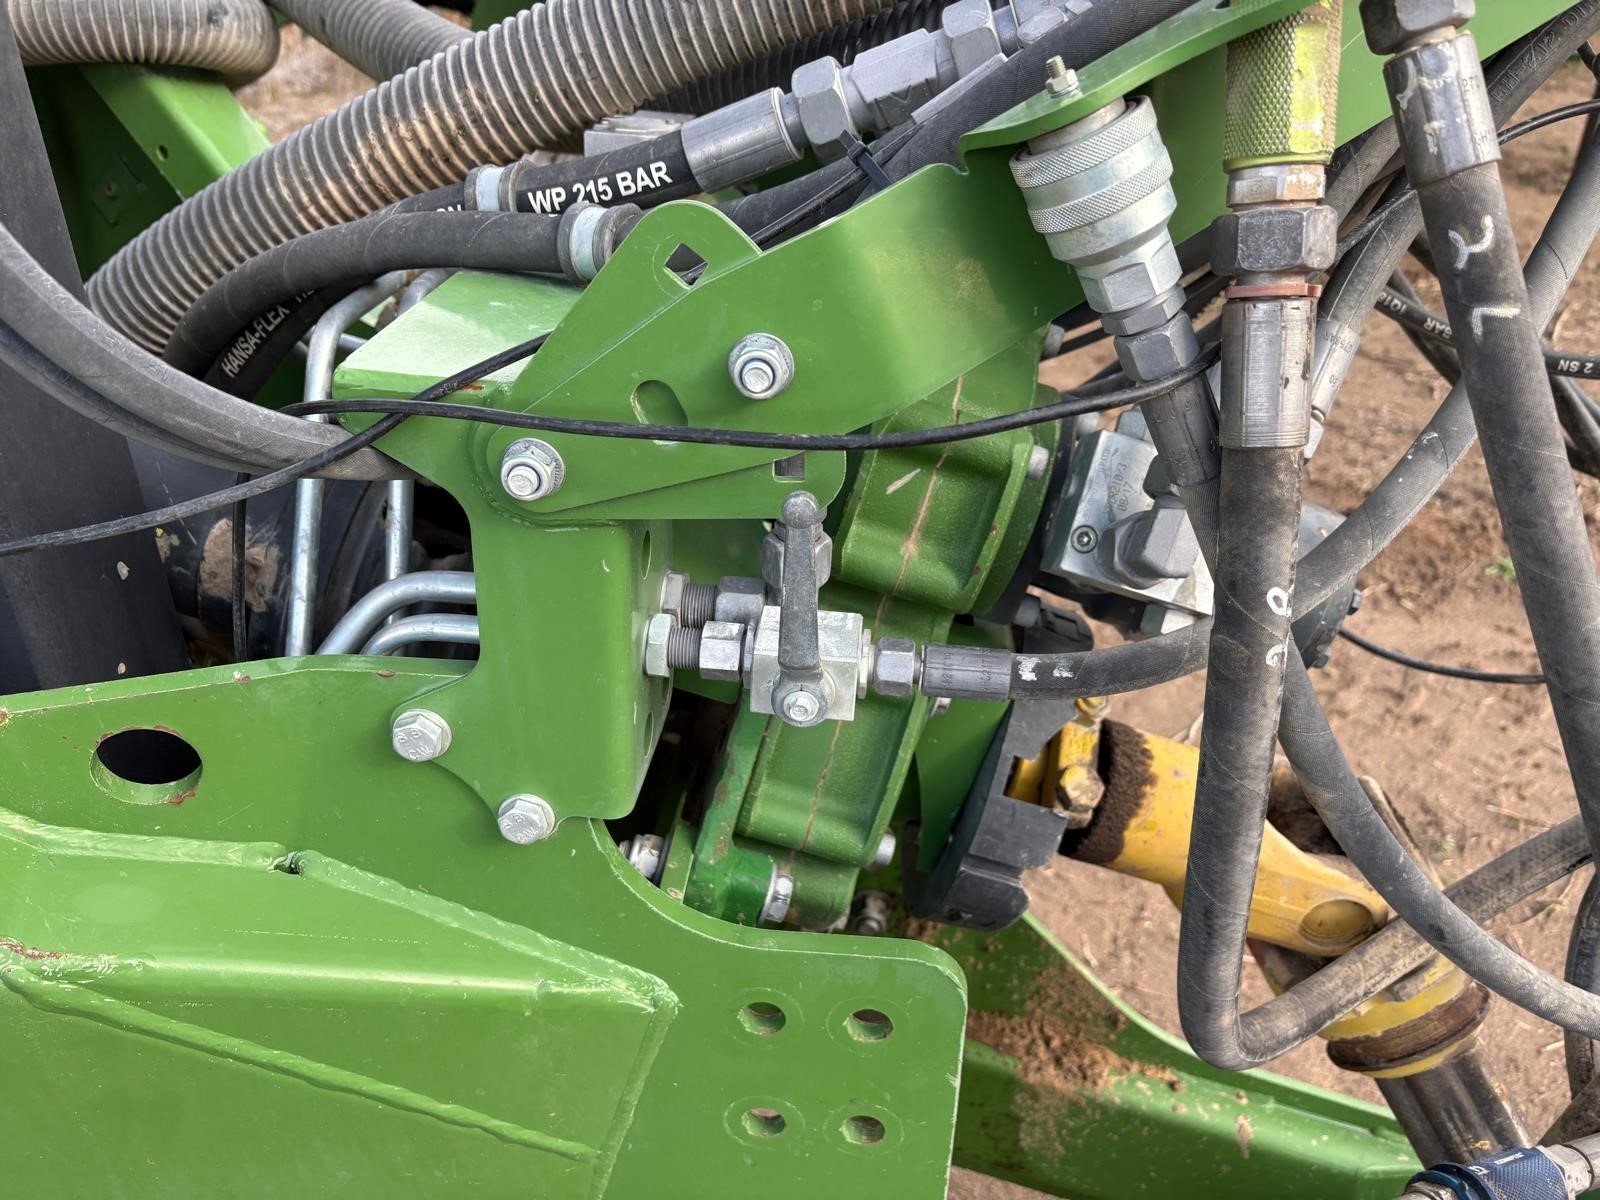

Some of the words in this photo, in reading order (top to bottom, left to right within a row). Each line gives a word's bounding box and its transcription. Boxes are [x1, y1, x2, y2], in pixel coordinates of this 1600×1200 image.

[527, 186, 567, 215] WP
[572, 177, 613, 203] 215
[616, 160, 673, 197] BAR
[220, 304, 291, 378] HANSA-FLEX
[1557, 359, 1581, 373] SN
[1583, 362, 1594, 374] 2
